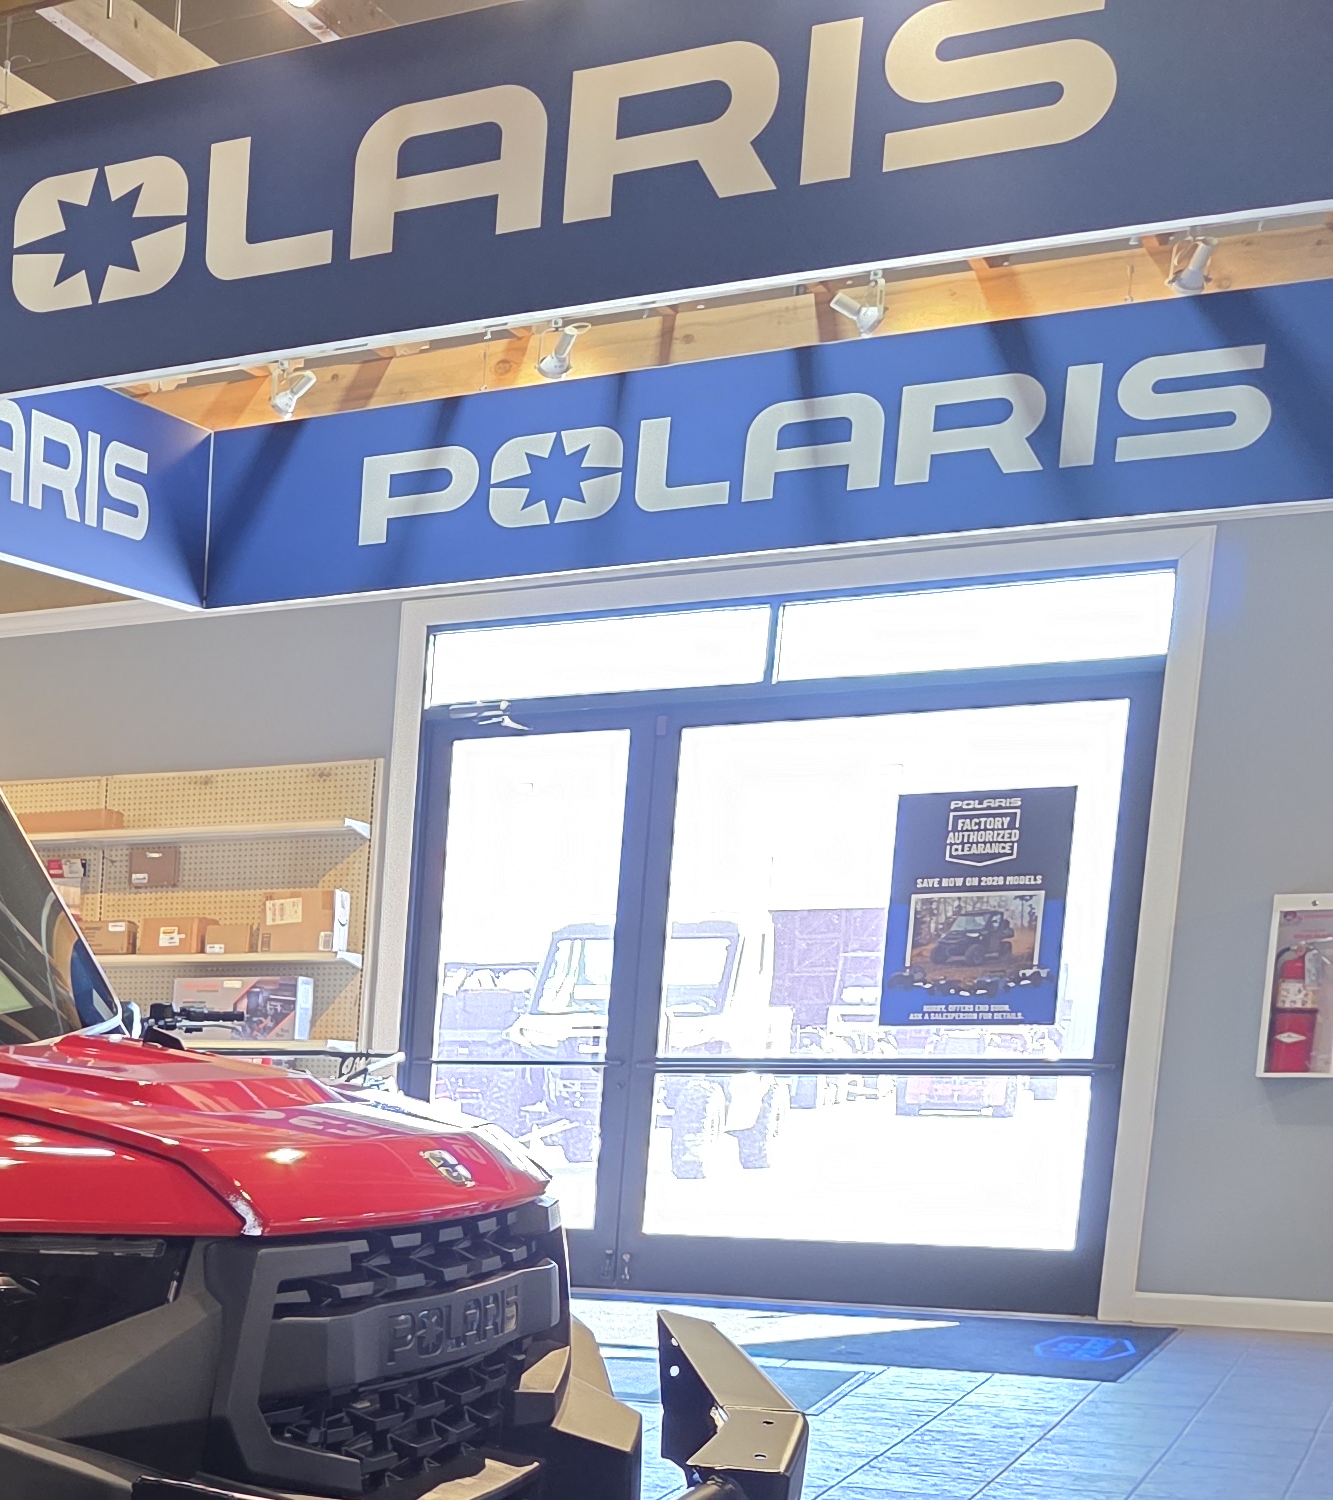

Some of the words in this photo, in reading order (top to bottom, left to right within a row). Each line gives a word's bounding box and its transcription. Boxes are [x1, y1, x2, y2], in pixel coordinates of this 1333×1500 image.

[357, 343, 1272, 547] POLARIS
[949, 797, 1022, 809] POLARIS
[957, 816, 1011, 830] FACTORY
[946, 829, 1020, 843] AUTHORIZED
[951, 843, 1012, 856] CLEARANCE
[916, 878, 940, 888] SAVE
[942, 877, 964, 887] NOW
[965, 877, 979, 886] ON
[1006, 875, 1042, 885] MODELS
[387, 1284, 521, 1366] POLARIS
